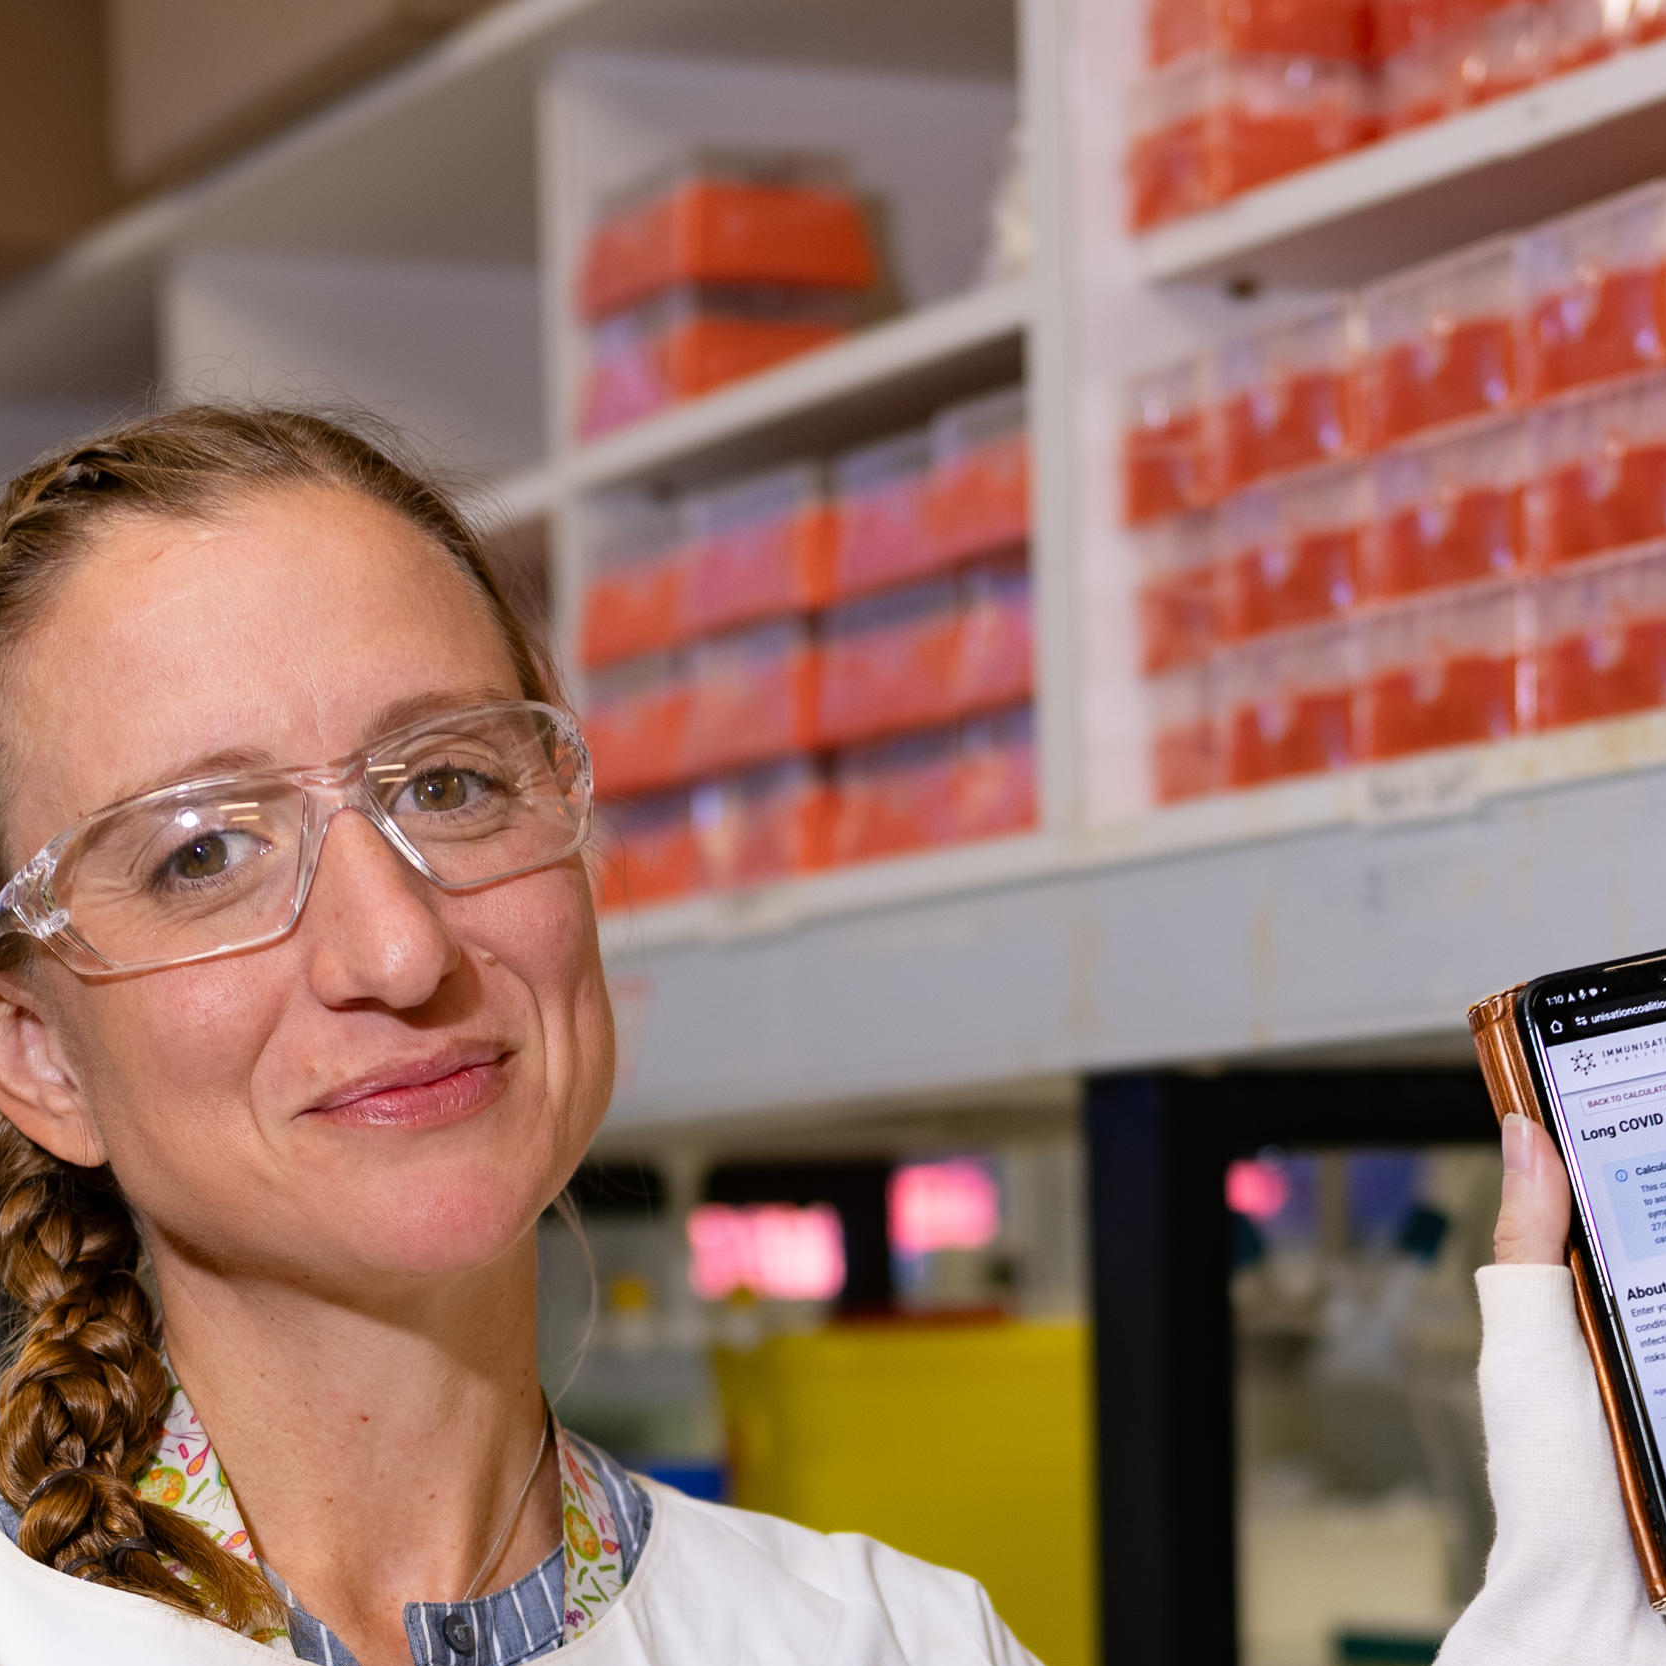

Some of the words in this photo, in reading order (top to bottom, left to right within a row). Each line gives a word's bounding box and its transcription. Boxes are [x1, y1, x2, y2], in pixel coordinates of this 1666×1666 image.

[1545, 994, 1564, 1006] 1:10
[1587, 1096, 1610, 1109] BACK
[1611, 1094, 1622, 1103] TO
[1581, 1124, 1617, 1141] Long
[1618, 1113, 1664, 1133] COVID
[1640, 1183, 1658, 1193] This
[1643, 1198, 1653, 1206] to
[1630, 1305, 1655, 1317] Enter
